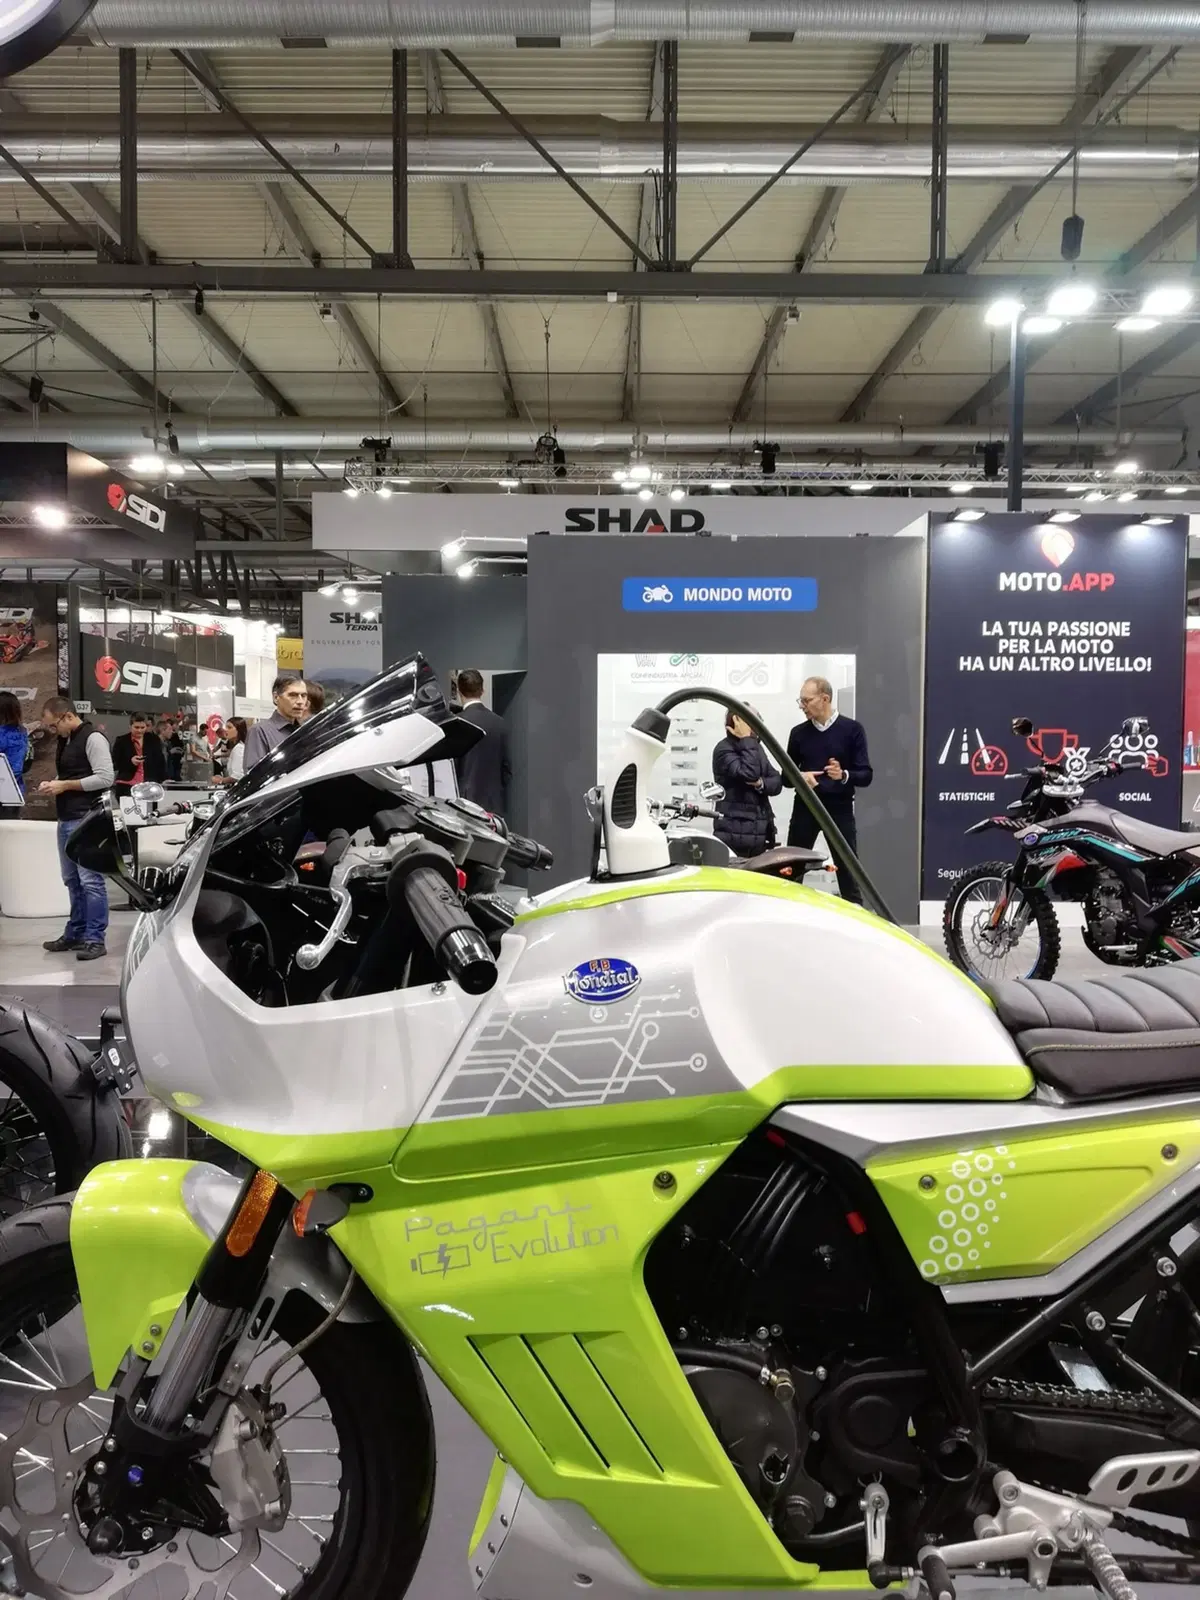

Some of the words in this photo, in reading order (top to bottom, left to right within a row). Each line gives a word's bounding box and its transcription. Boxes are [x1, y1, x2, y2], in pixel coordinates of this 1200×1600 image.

[125, 494, 166, 532] SDI
[565, 508, 705, 533] SHAD
[999, 572, 1115, 591] MOTO.APP
[684, 587, 742, 601] MONDO
[747, 587, 792, 601] MOTO
[982, 621, 1003, 636] LA
[1008, 621, 1043, 636] TUA
[1048, 622, 1131, 636] PASSIONE
[998, 639, 1030, 653] PER
[1034, 639, 1056, 653] LA
[1060, 639, 1114, 653] MOTO
[959, 656, 984, 671] HA
[989, 657, 1014, 671] UN
[1018, 657, 1075, 671] ALTRO
[1079, 657, 1152, 672] LIVELLO!
[120, 661, 172, 698] SDI
[939, 792, 995, 801] STATISTICHE
[1118, 792, 1152, 801] SOCIAL
[562, 967, 638, 994] Mondial
[490, 1212, 620, 1263] Evolution
